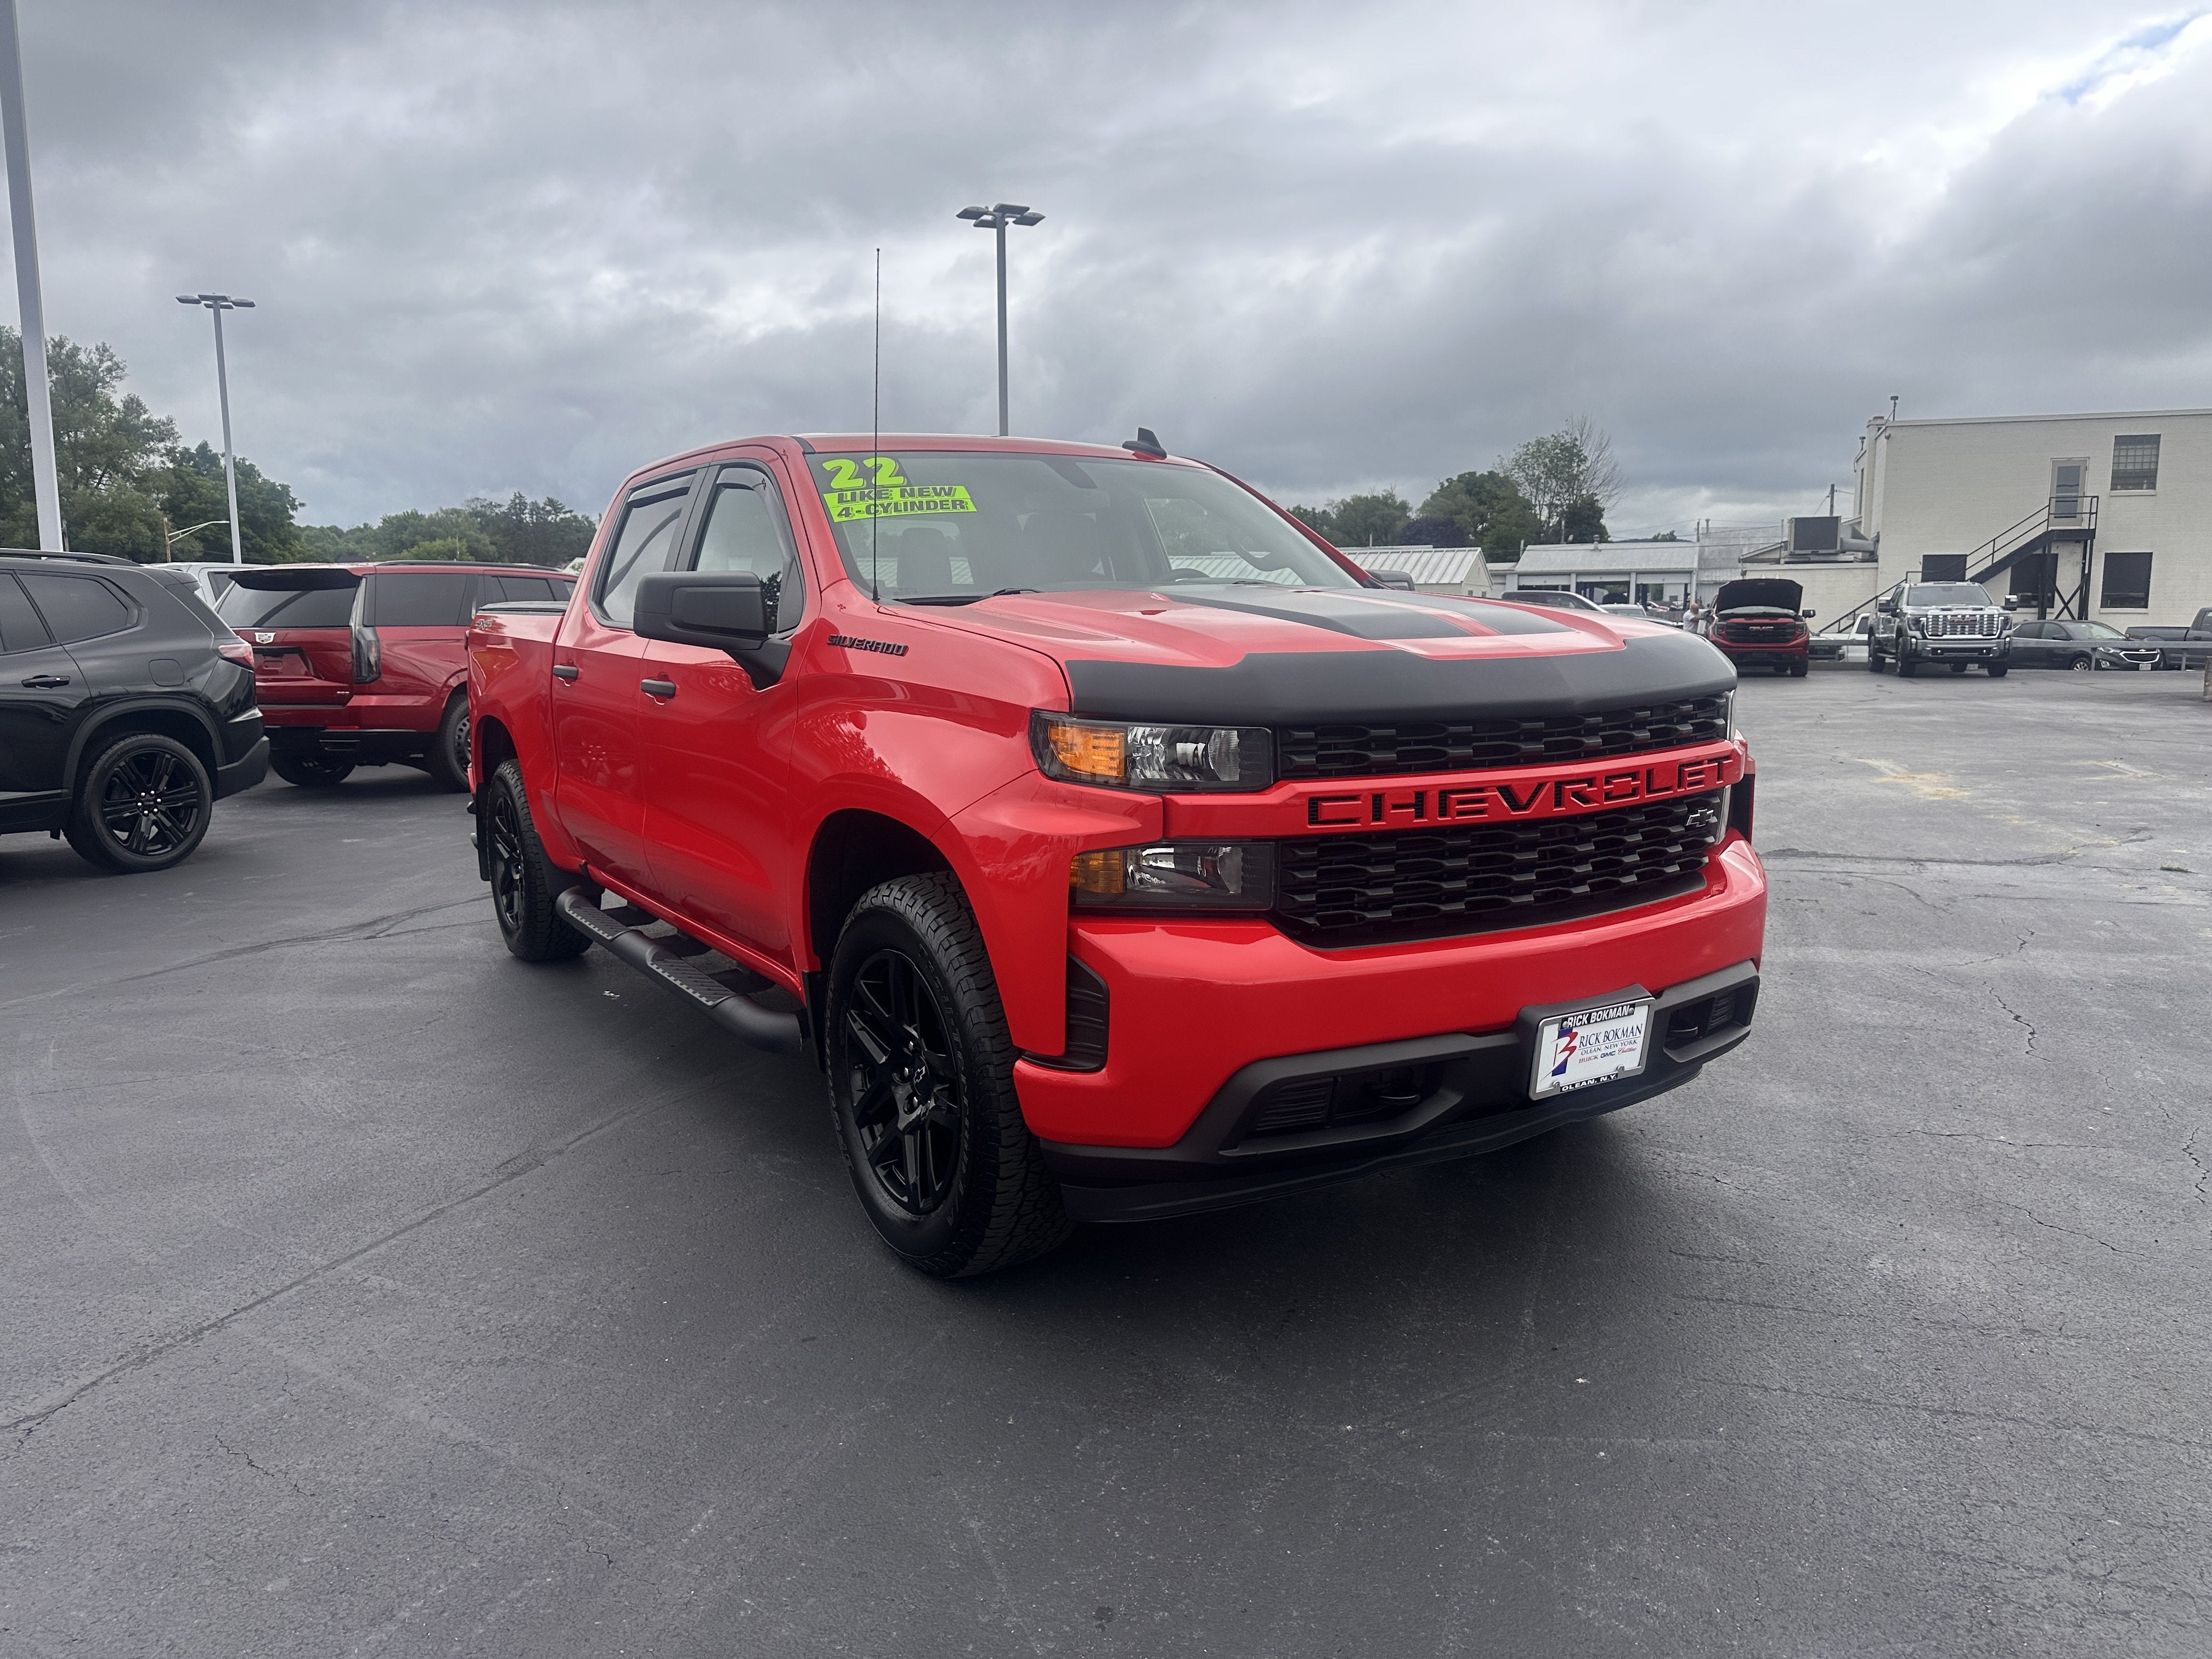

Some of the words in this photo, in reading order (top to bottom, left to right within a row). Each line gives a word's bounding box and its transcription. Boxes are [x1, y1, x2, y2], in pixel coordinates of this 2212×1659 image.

[822, 457, 907, 489] 22
[838, 489, 893, 504] LIKE
[900, 487, 956, 499] NEW
[837, 499, 968, 518] 4-CYLINDER
[826, 634, 910, 657] SILVERADO
[1306, 757, 1734, 827] CHEVROLET
[1567, 1013, 1589, 1028] RICK
[1590, 1005, 1630, 1024] BOKMAN
[1578, 1031, 1602, 1048] RICK
[1602, 1023, 1643, 1043] BOKMAN
[1604, 1042, 1619, 1051] NEW
[1578, 1054, 1598, 1063] BUICK
[1600, 1074, 1617, 1082] N.Y.
